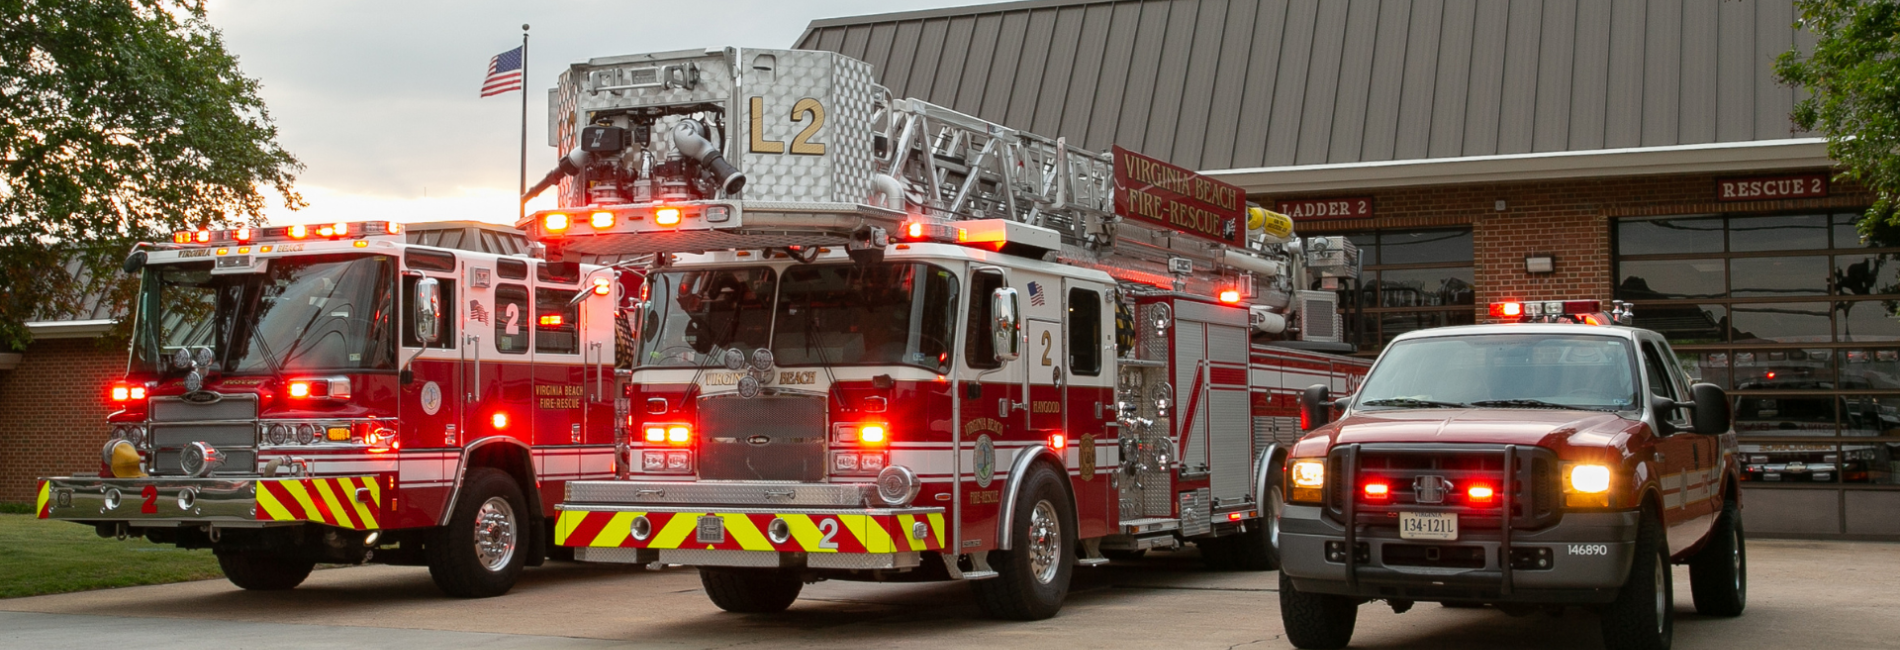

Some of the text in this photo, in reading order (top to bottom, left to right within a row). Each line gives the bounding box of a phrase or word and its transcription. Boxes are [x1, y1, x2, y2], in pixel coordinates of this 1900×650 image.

[749, 96, 826, 156] L2
[1124, 153, 1237, 211] VIRGINIA BEACH
[1723, 178, 1822, 198] RESCUE 2
[1129, 188, 1220, 237] FIRE-RESCUE
[1282, 202, 1351, 217] LADDER
[1358, 200, 1367, 214] 2
[178, 244, 304, 258] VIRGINIA BEACH
[505, 302, 519, 335] 2
[1041, 330, 1052, 366] 2
[705, 371, 816, 386] VIRGIN BEACH
[535, 385, 583, 396] VIRGINIA BEACH
[539, 398, 580, 409] FIRE-RESCUE
[1032, 401, 1060, 413] HAYGOOD
[141, 485, 157, 514] 2
[819, 518, 839, 549] 2
[1404, 518, 1455, 533] 134-121L
[1567, 544, 1607, 556] 146890
